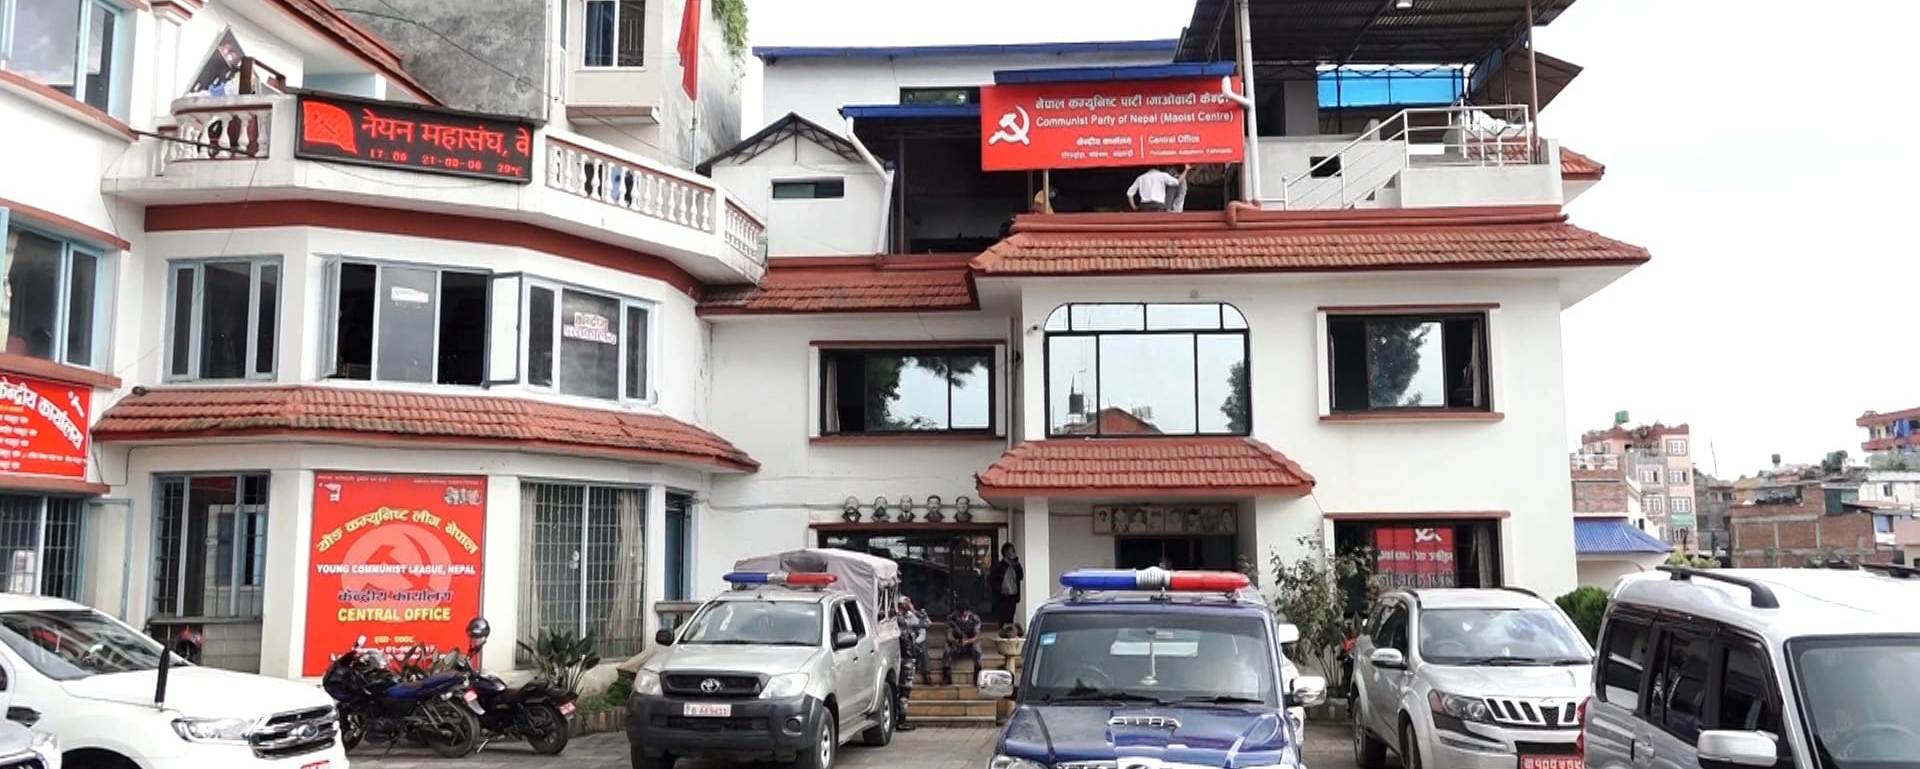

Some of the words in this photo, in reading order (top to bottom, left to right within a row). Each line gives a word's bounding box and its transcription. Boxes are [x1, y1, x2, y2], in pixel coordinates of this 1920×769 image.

[1036, 115, 1089, 127] Communist
[1090, 114, 1116, 127] Party
[1118, 115, 1128, 124] of
[1130, 114, 1157, 125] Nepal
[1160, 112, 1195, 125] (Maoist
[1197, 111, 1233, 122] Centre)
[316, 564, 350, 575] YOUNG
[351, 564, 407, 576] COMMUNIST
[408, 565, 446, 576] LEAGUE,
[447, 565, 476, 576] NEPAL
[338, 607, 400, 621] CENTRAL
[405, 607, 451, 621] OFFICE
